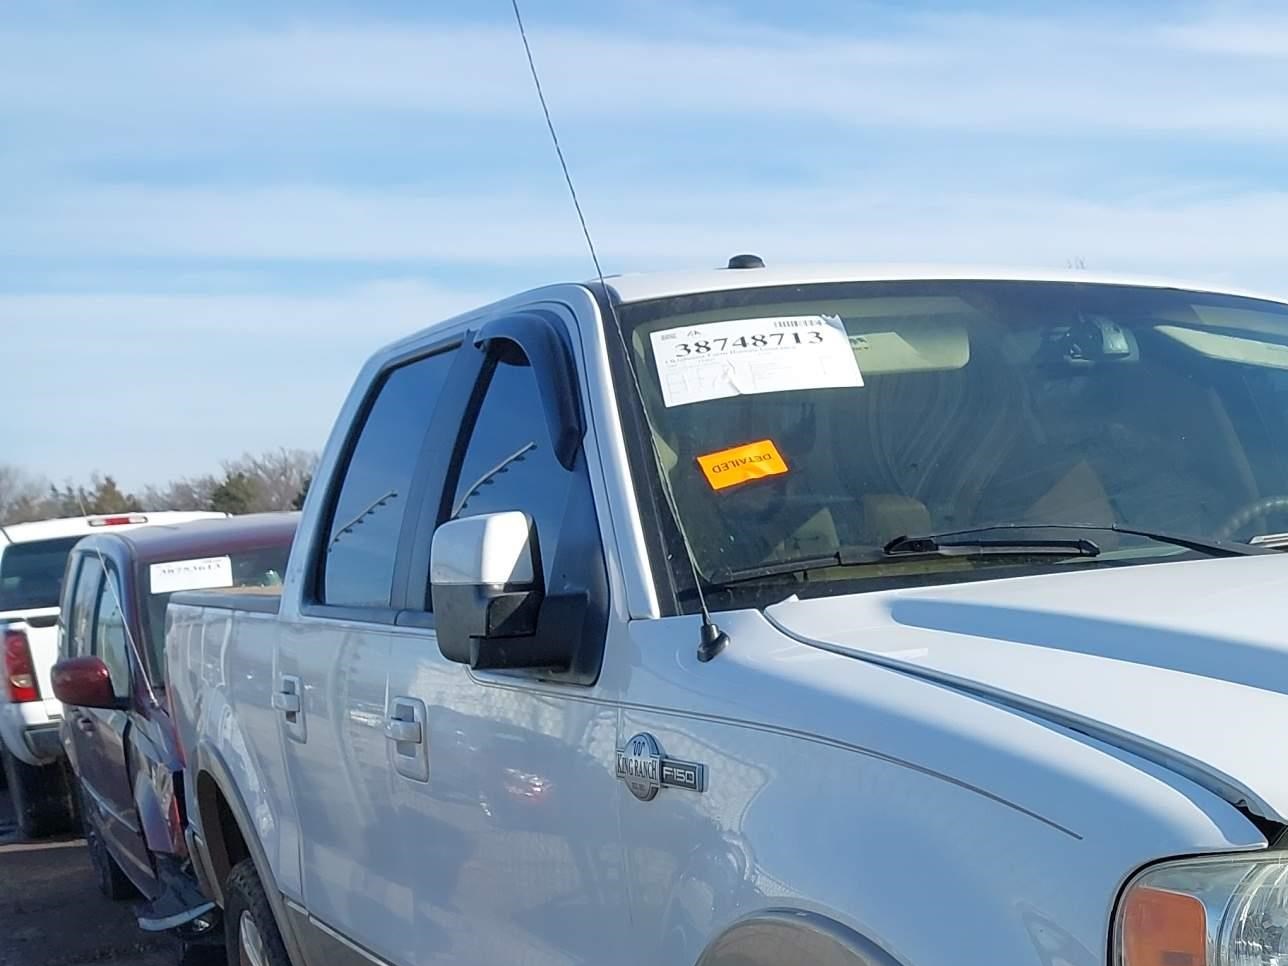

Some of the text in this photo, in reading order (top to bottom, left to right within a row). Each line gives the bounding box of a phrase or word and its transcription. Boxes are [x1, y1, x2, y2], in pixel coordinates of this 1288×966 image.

[674, 331, 824, 358] 38748713
[711, 452, 773, 474] DETAILED
[617, 753, 658, 781] KING RANCH
[662, 766, 696, 784] F150
